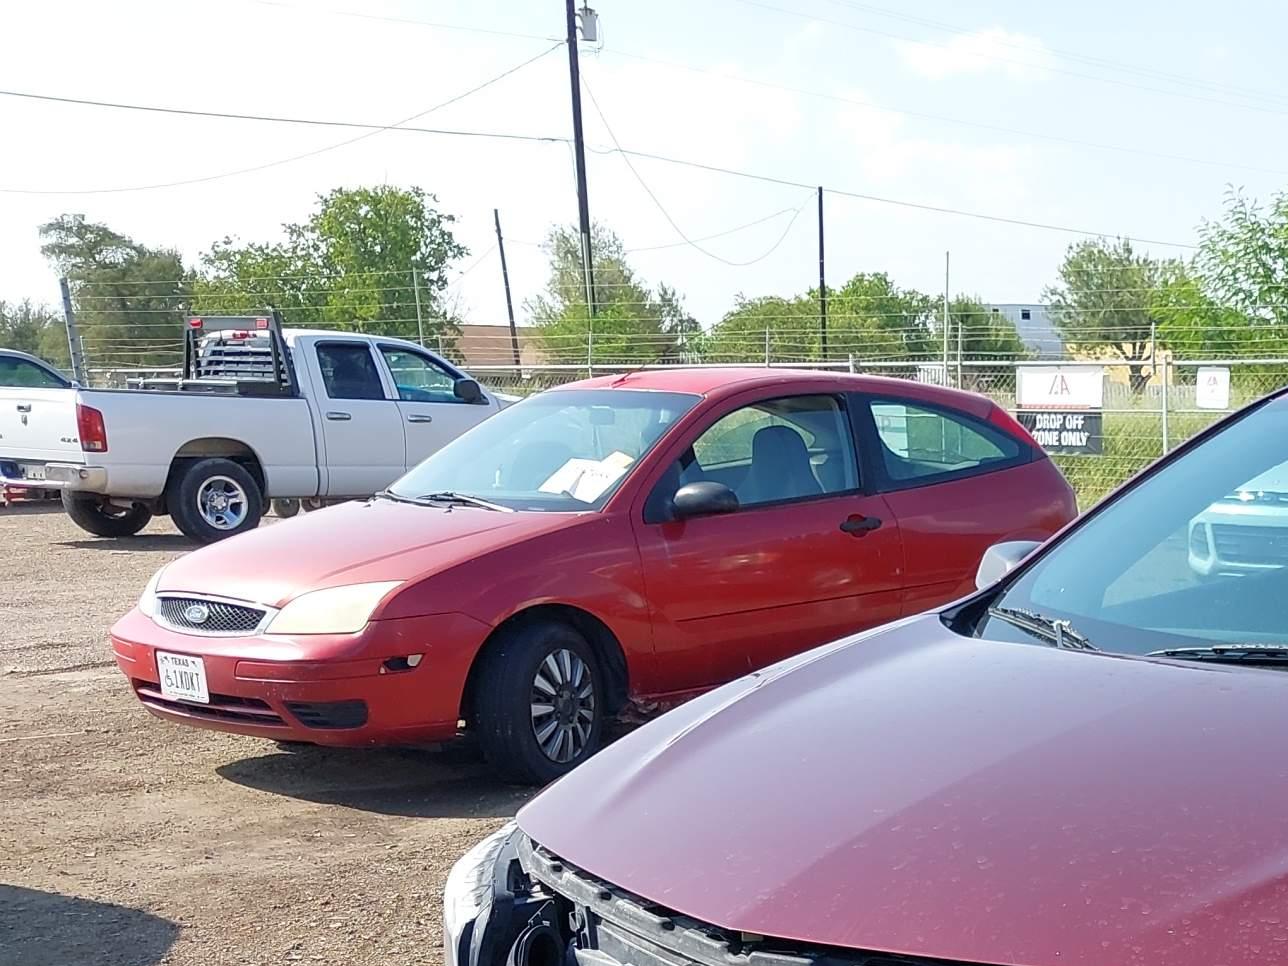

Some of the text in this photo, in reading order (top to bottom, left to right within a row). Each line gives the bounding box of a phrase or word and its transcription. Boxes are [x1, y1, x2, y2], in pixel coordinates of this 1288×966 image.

[1035, 414, 1084, 430] DROP OFF
[1061, 431, 1090, 446] ONLY
[170, 656, 190, 668] TEXAS
